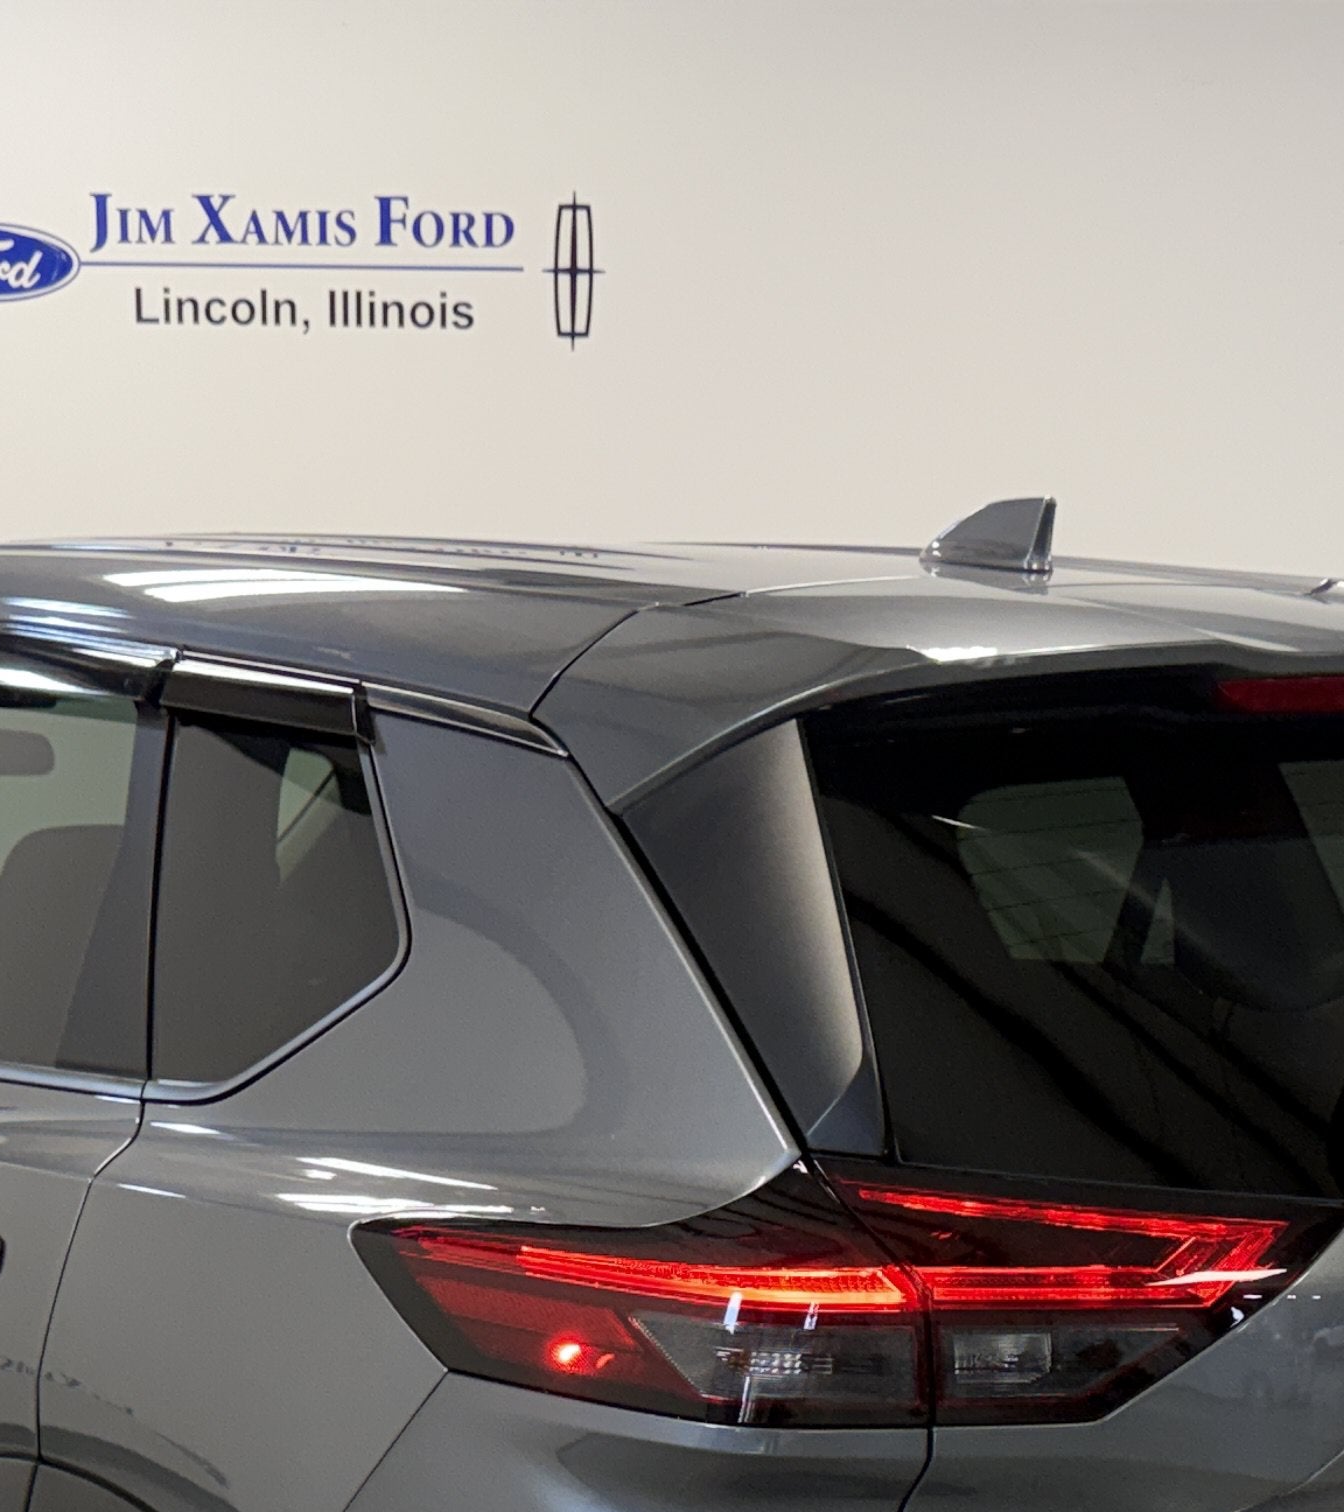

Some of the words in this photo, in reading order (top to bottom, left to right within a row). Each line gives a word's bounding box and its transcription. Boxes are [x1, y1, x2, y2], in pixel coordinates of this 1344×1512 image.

[90, 193, 174, 252] JIM
[192, 194, 357, 247] XAMIS
[374, 196, 514, 248] FORD
[136, 288, 310, 333] Lincoln,
[329, 290, 474, 330] Illinois
